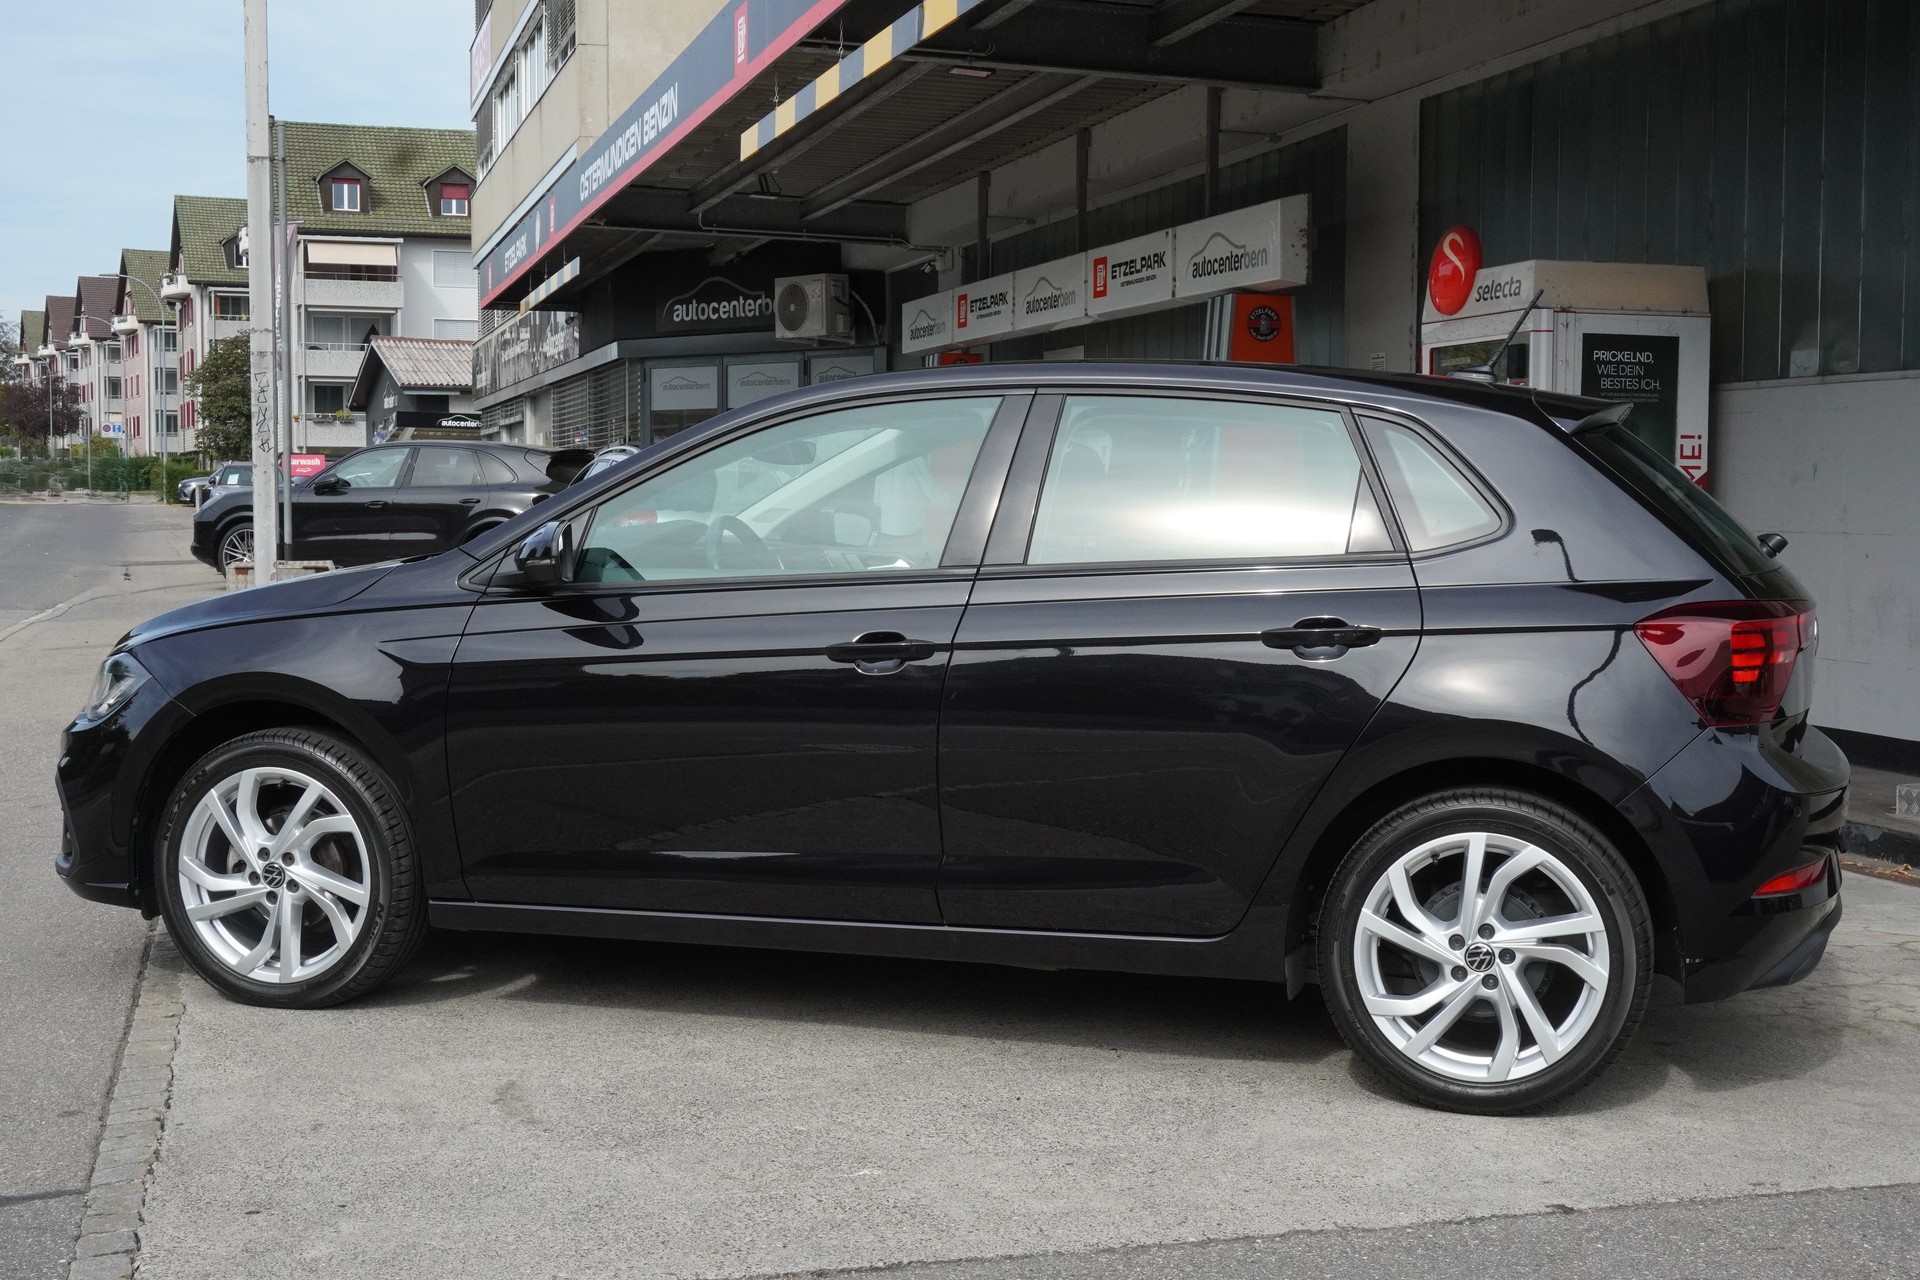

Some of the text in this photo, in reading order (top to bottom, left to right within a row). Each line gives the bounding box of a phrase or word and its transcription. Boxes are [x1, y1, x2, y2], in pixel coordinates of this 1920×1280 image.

[580, 82, 678, 201] OSTERMUNDIGEN BENZIN
[1111, 251, 1167, 280] ETZELPARK
[1192, 247, 1268, 279] autocenterbern
[1475, 276, 1522, 303] selecta
[673, 296, 774, 322] autocenterb
[970, 291, 1009, 314] ETZELPARK
[1025, 289, 1076, 315] autocenterbern
[909, 320, 946, 341] autocenterbern
[1593, 350, 1654, 364] PRICKELND,
[1597, 364, 1644, 376] WIE DEIN
[663, 382, 711, 391] autocenterbern
[740, 377, 791, 387] autocenterbern
[1601, 378, 1662, 390] BESTES ICH.
[291, 458, 321, 466] arwash
[163, 769, 208, 841] NEXEN
